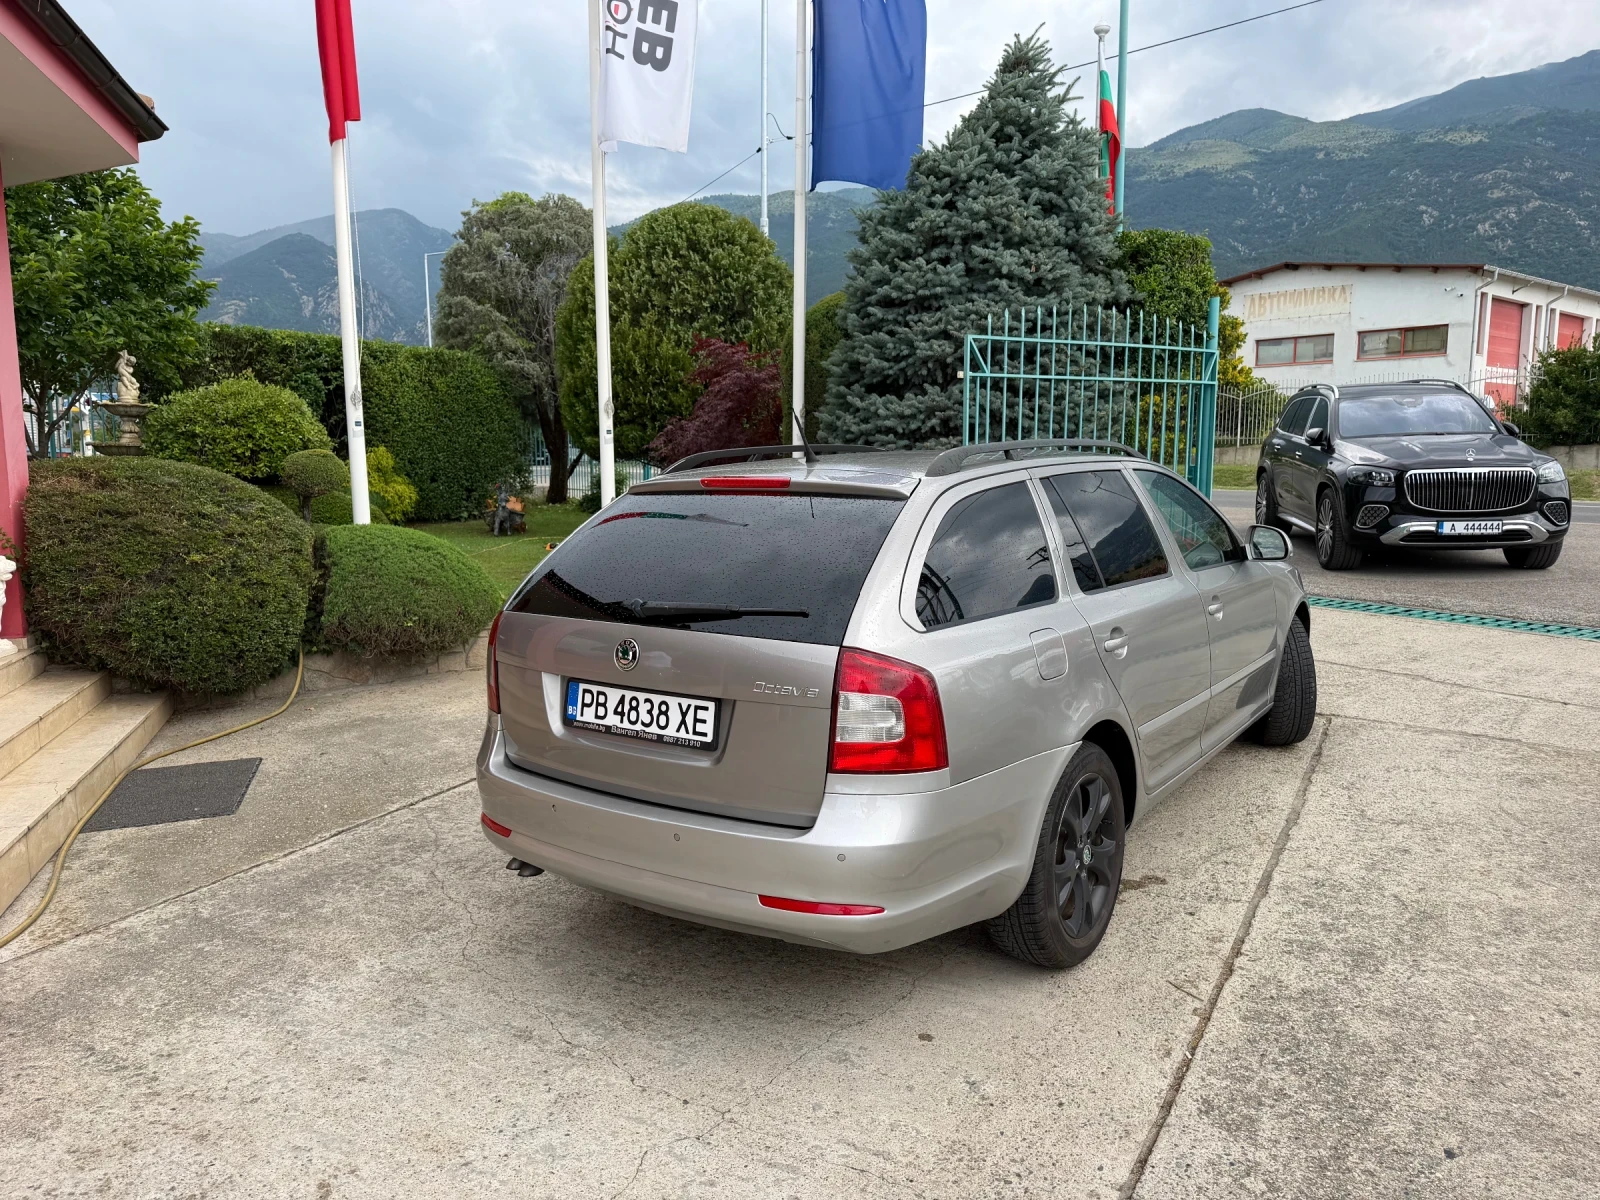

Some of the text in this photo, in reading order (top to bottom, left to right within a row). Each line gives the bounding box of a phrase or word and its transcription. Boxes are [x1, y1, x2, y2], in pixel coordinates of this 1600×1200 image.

[1247, 286, 1348, 320] АВТОМИВКА
[1450, 523, 1456, 532] A
[1463, 523, 1500, 532] 444444
[752, 681, 820, 698] Octavia
[580, 688, 709, 738] PB 4838 XE
[611, 725, 658, 741] Вангел Янев
[678, 738, 689, 746] 213
